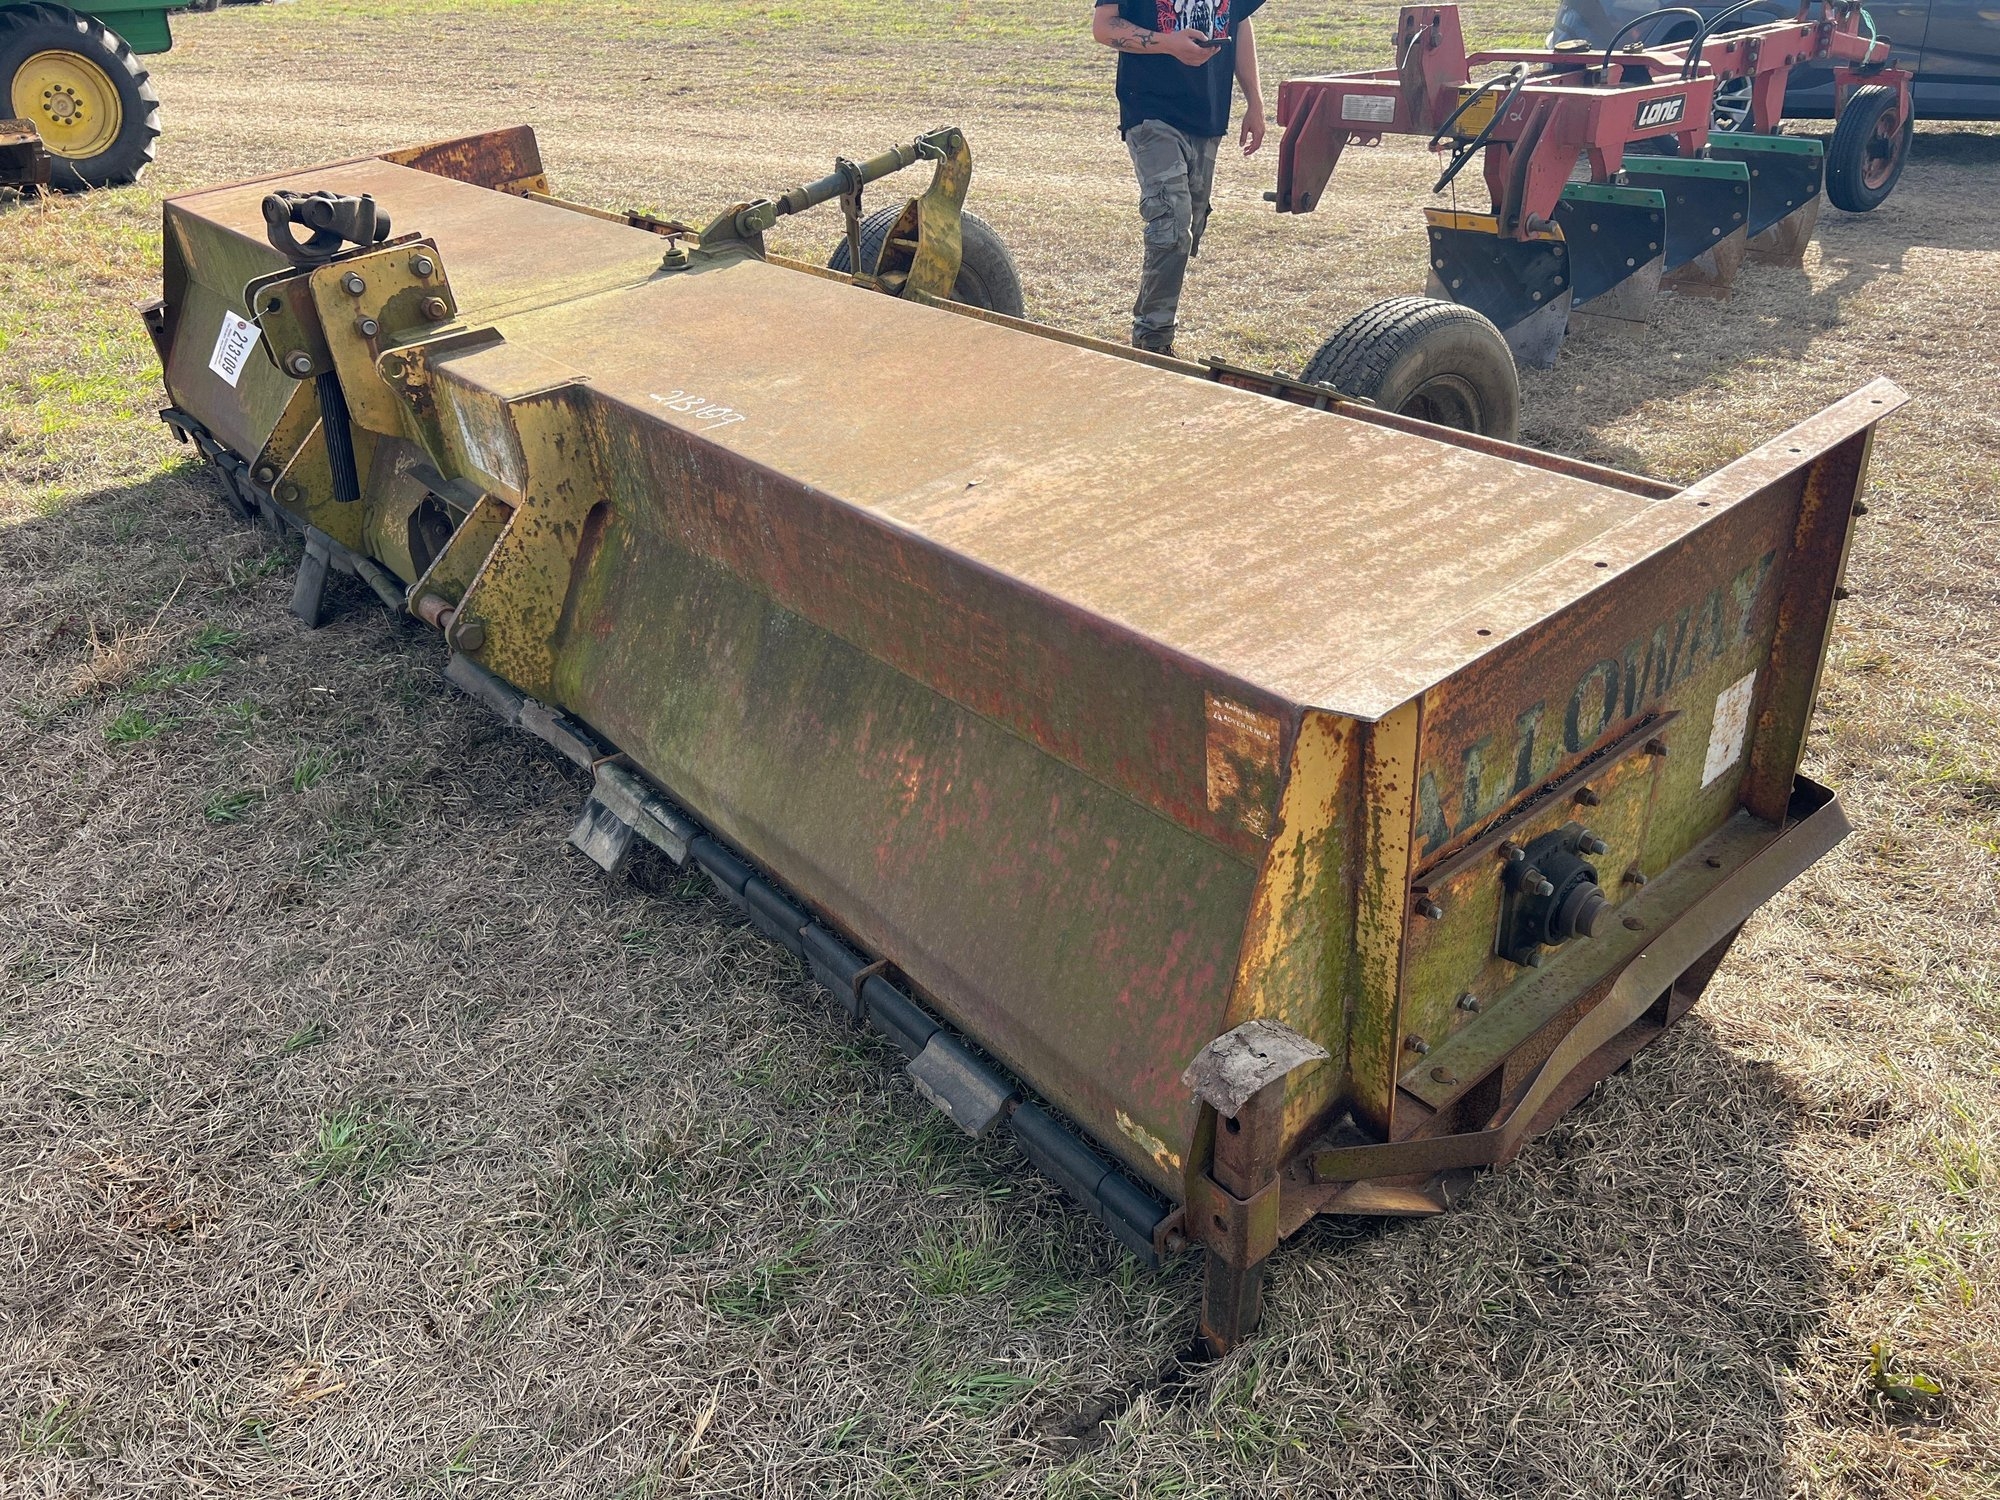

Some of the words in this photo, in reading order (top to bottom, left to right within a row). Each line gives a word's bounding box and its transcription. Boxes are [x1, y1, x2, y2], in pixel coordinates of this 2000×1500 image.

[1638, 99, 1682, 126] LONG
[221, 330, 249, 376] 213109
[649, 390, 746, 431] 213109
[1223, 714, 1271, 740] ADVERTENCIA
